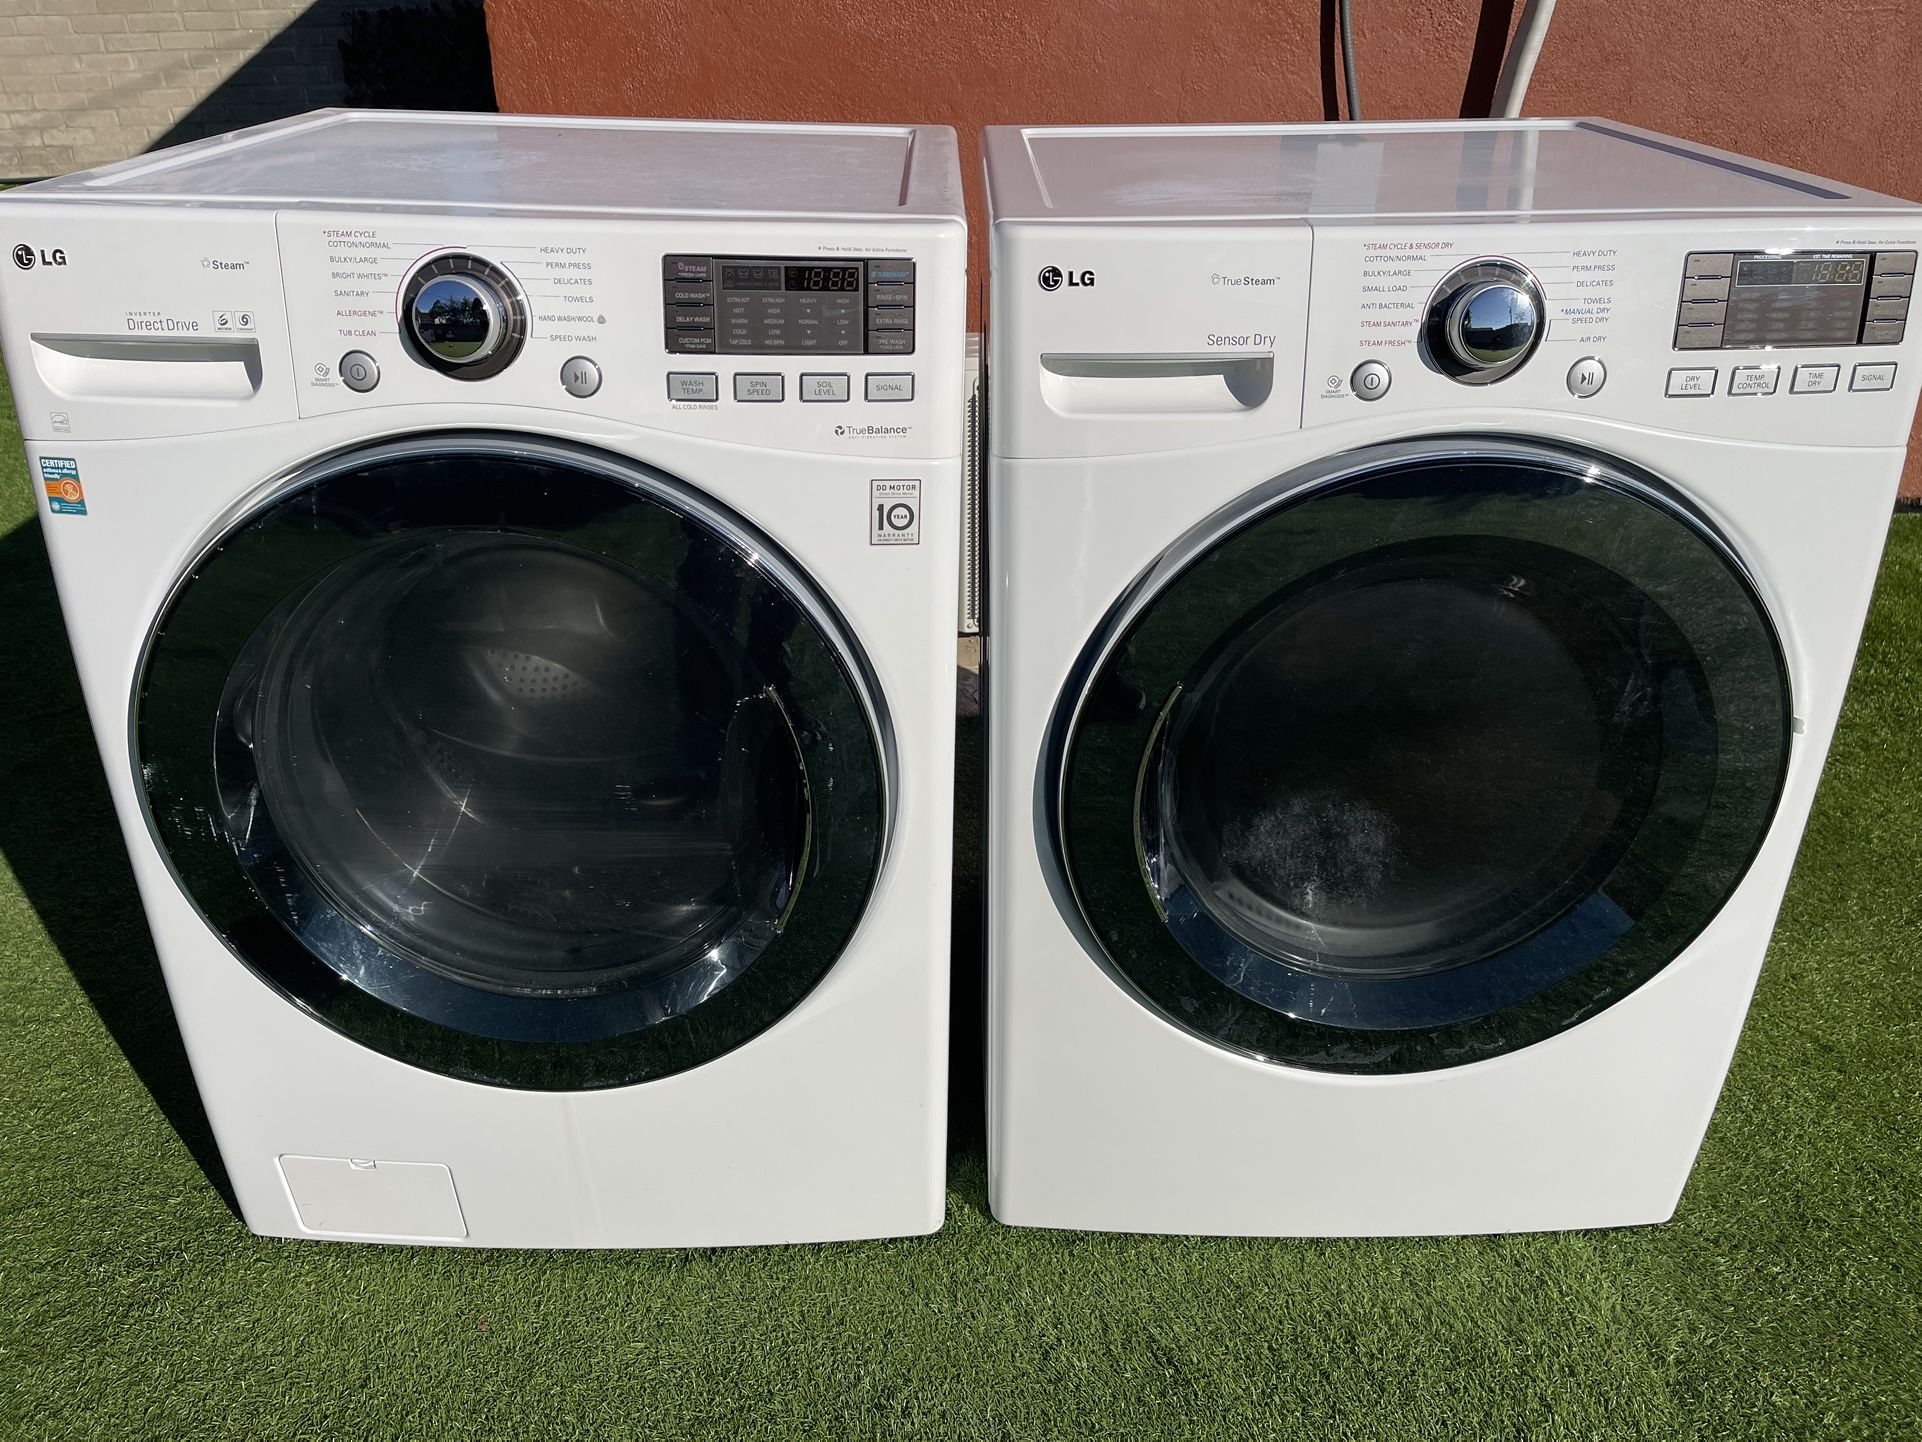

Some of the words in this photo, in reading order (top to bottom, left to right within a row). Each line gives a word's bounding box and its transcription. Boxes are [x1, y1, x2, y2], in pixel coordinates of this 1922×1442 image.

[328, 240, 391, 249] COTTON/NORMAL
[40, 248, 67, 266] LG
[330, 256, 378, 264] BULKY/LARGE
[1364, 254, 1427, 263] COTTON/NORMAL
[554, 278, 593, 286] DELICATES
[1068, 270, 1095, 287] LG
[1207, 334, 1250, 346] Sensor
[1254, 334, 1276, 348] Dry
[41, 459, 75, 468] CERTIFIED
[877, 503, 914, 531] 10
